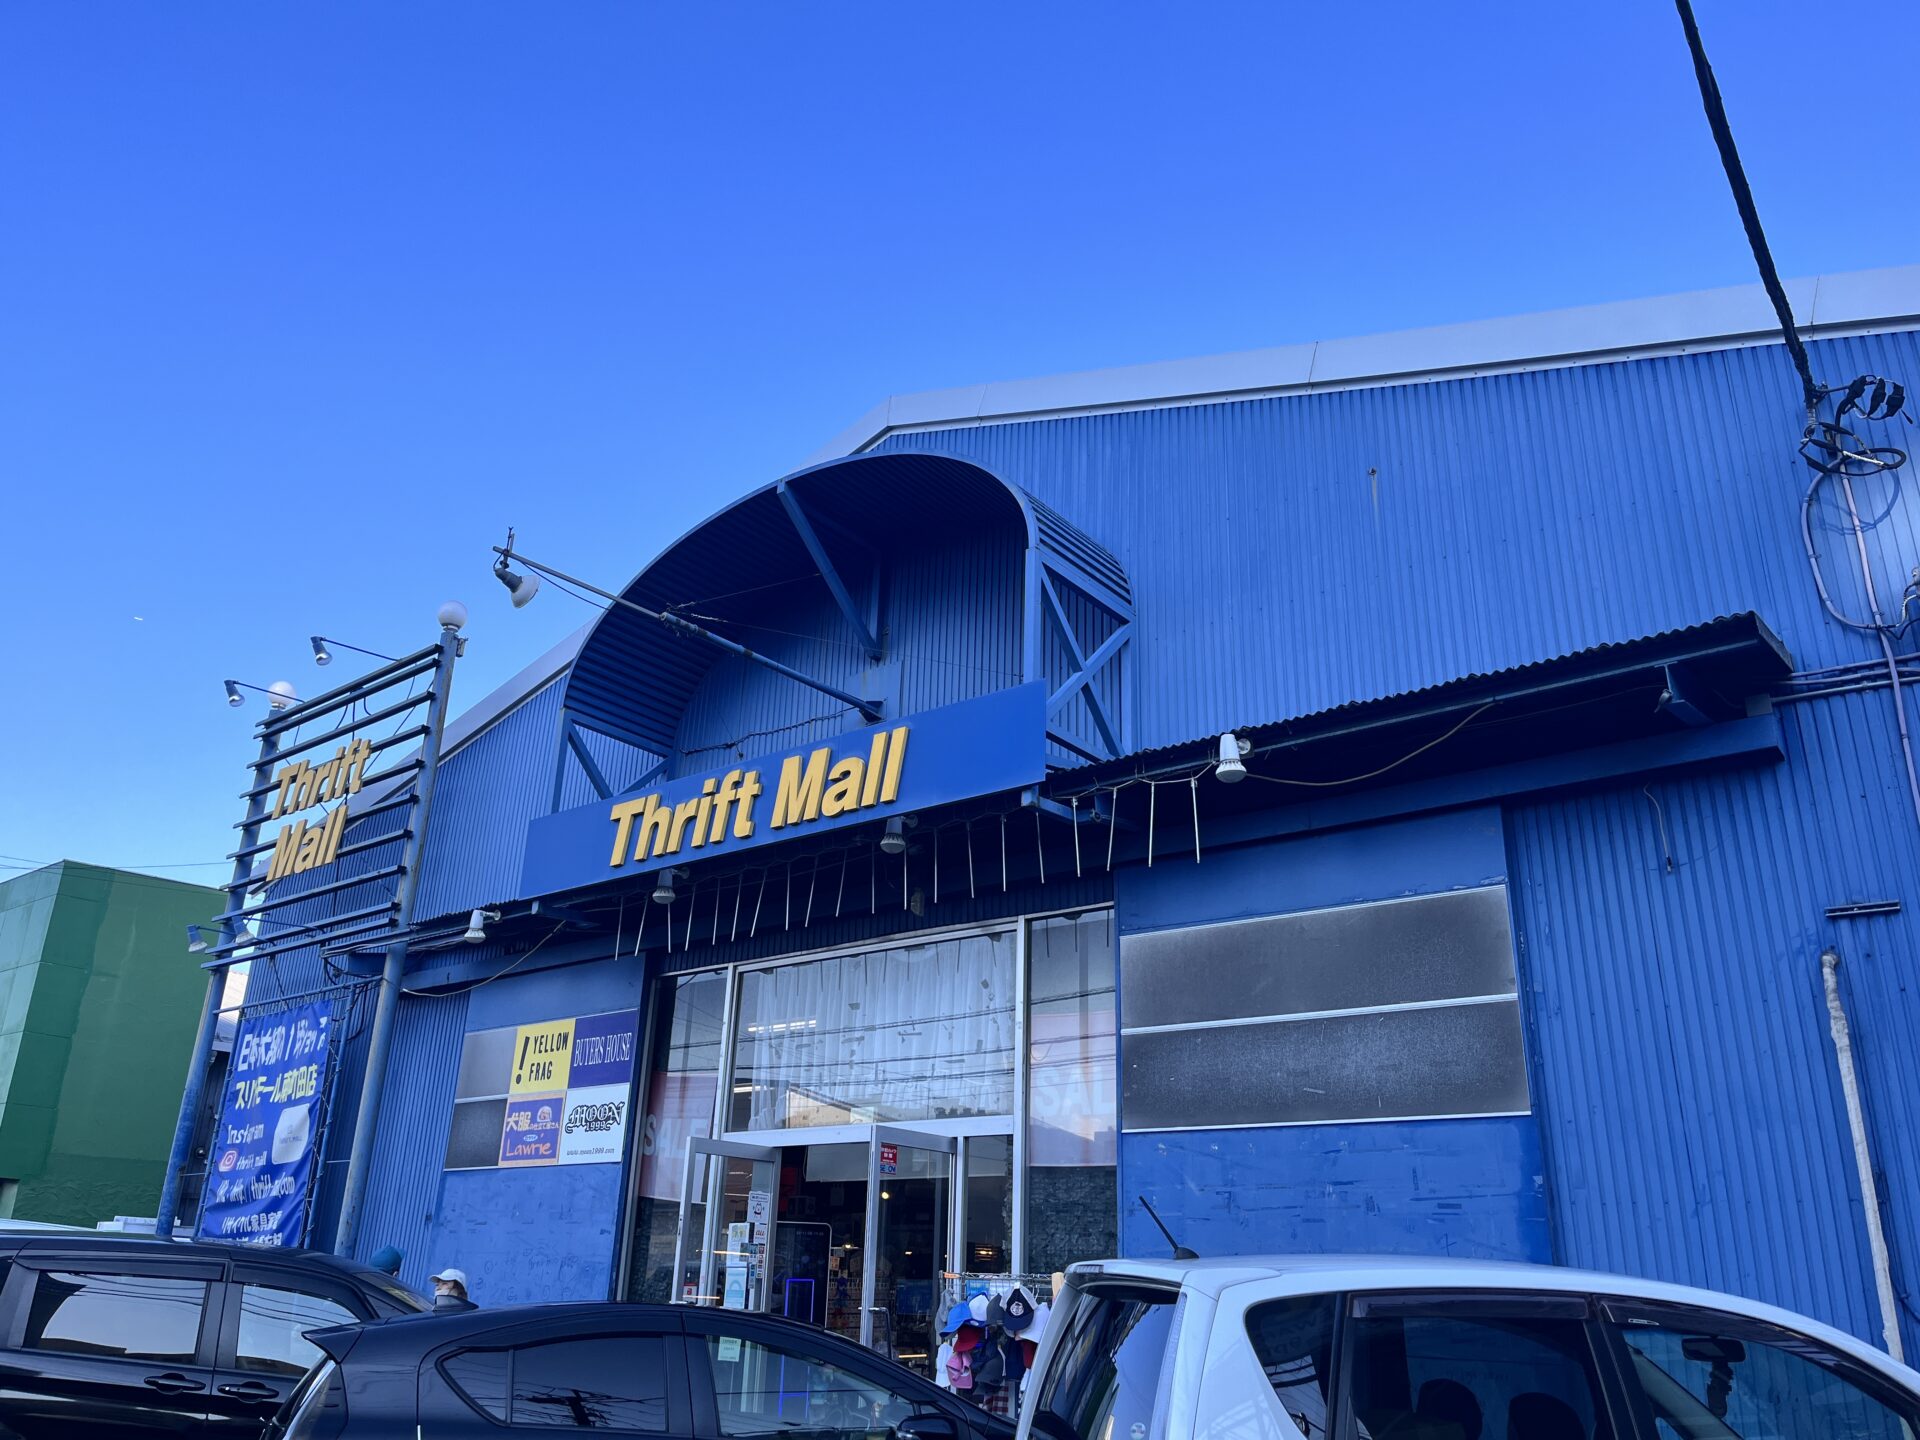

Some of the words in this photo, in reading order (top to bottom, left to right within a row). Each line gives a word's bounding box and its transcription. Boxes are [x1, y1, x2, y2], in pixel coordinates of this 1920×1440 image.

[271, 738, 371, 820] Thrift
[609, 768, 763, 868] Thrift
[769, 725, 910, 830] Mall
[266, 804, 348, 881] Mall
[533, 1031, 570, 1055] YELLOW
[574, 1036, 604, 1067] BUYERS
[604, 1032, 632, 1064] HOUSE
[528, 1061, 553, 1082] FRAG
